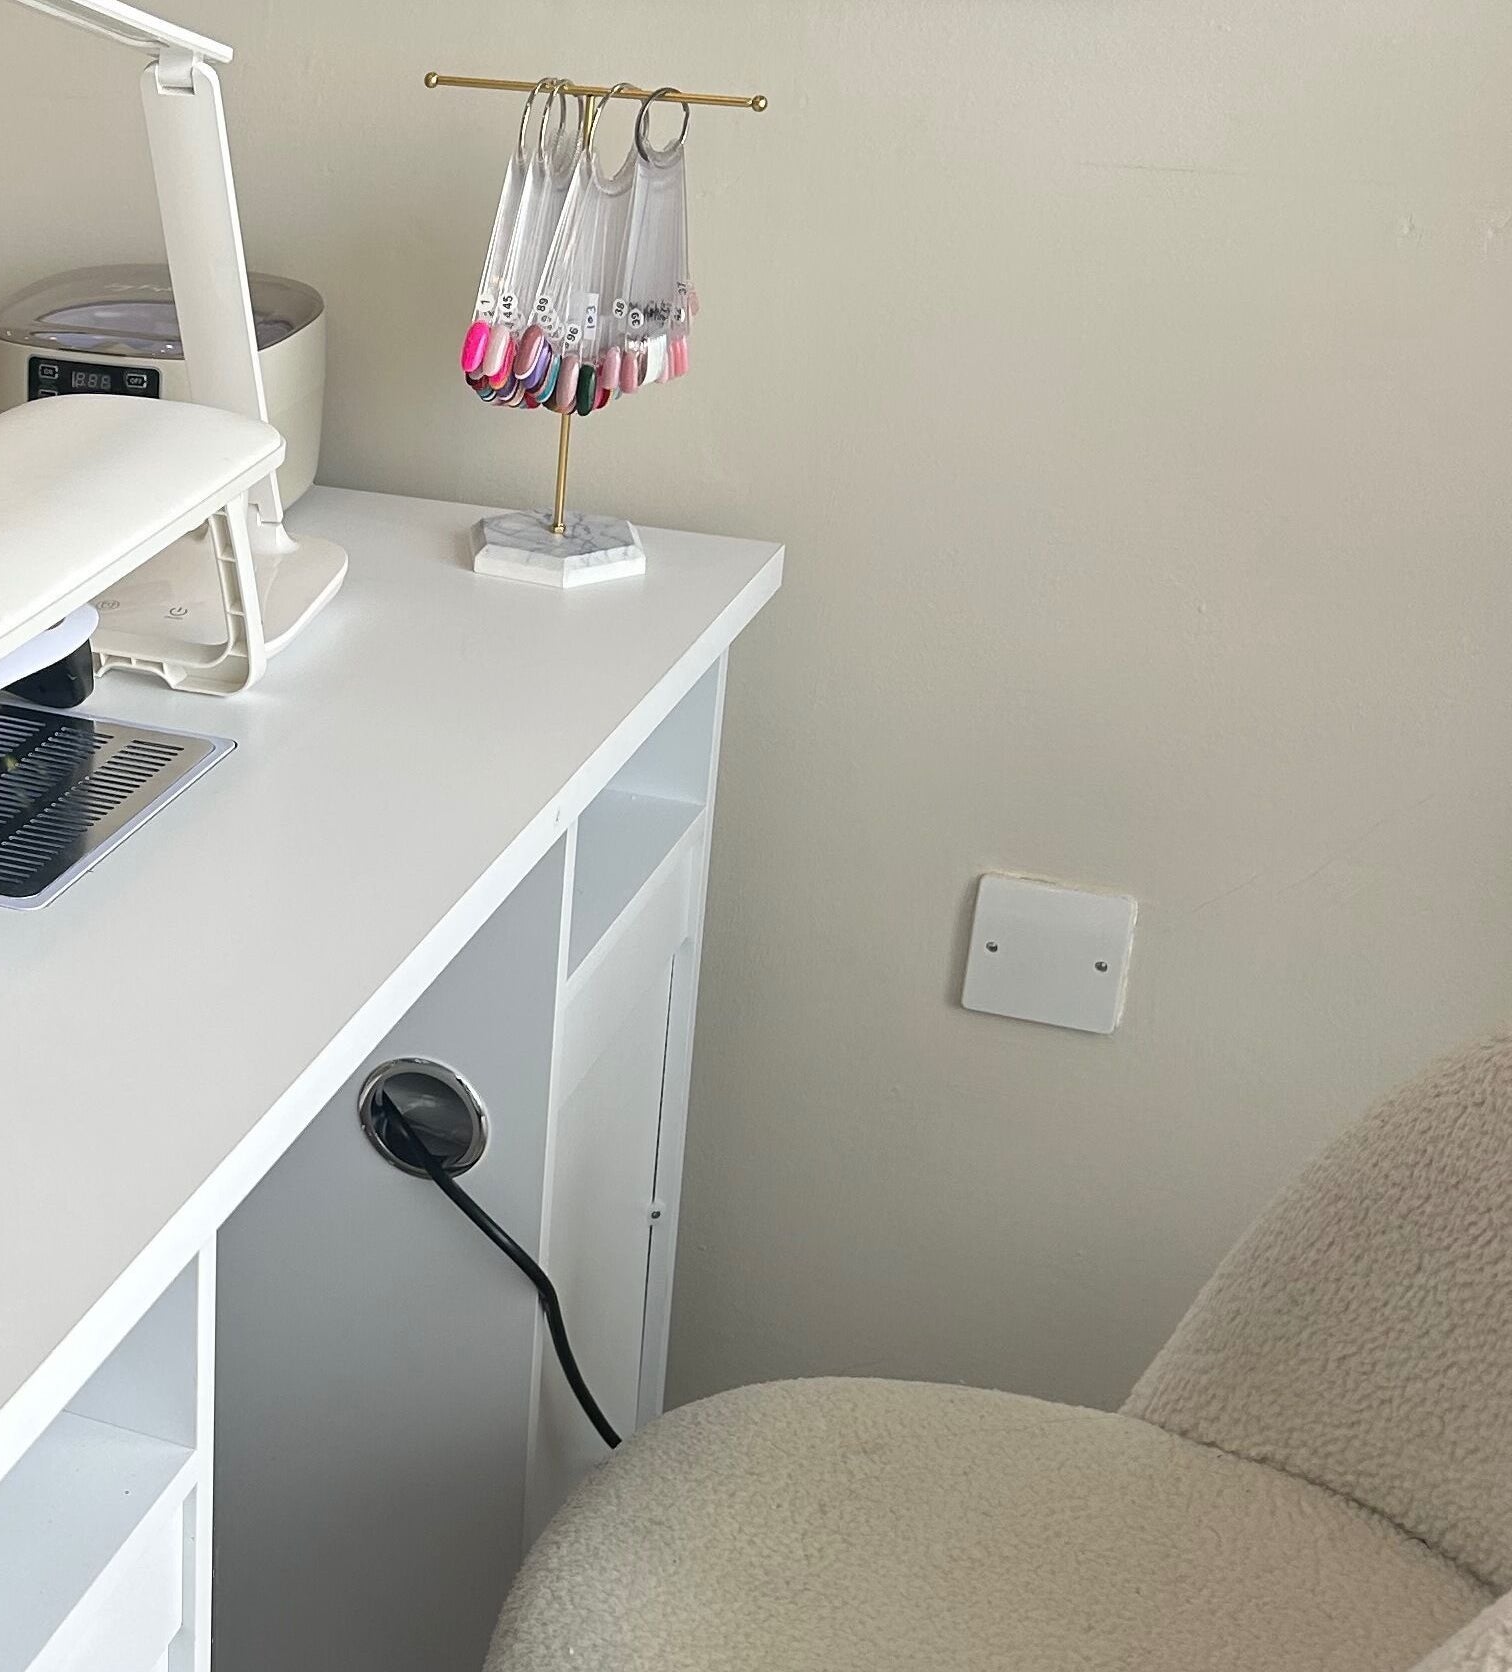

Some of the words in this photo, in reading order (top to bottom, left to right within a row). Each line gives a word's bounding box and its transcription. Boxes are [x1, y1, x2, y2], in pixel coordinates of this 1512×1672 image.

[502, 295, 513, 309] 45
[537, 298, 549, 312] 89
[615, 302, 625, 316] 38
[631, 312, 640, 326] 39
[567, 327, 578, 341] 96
